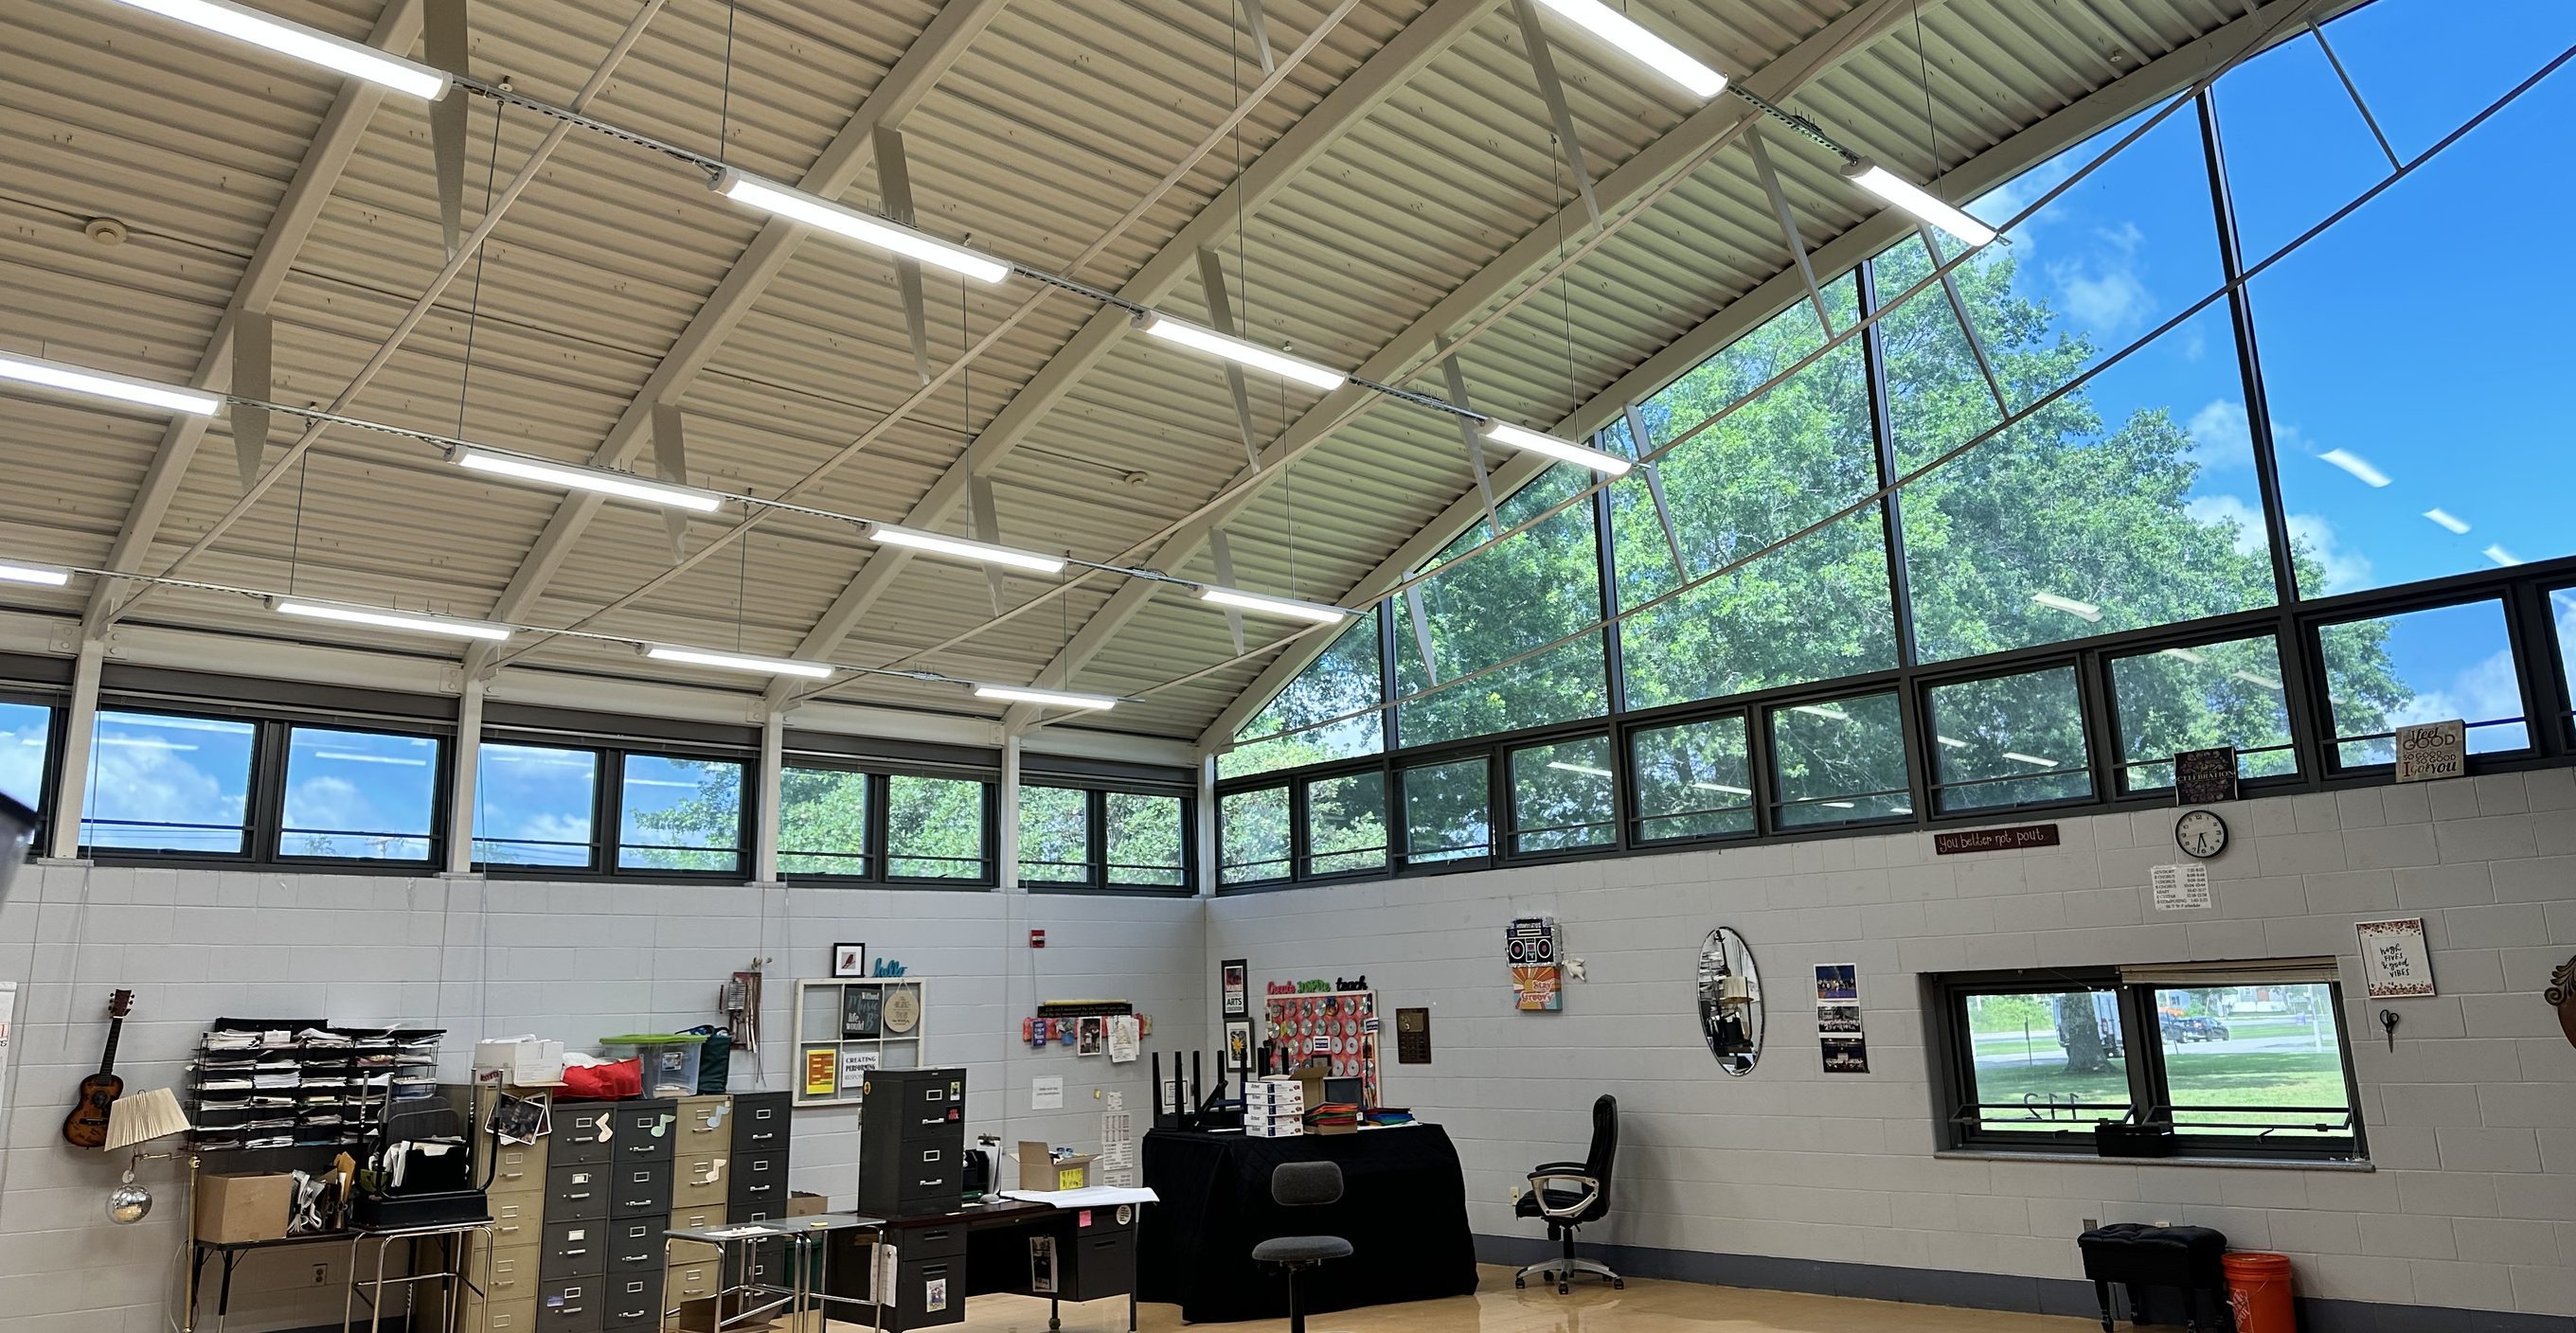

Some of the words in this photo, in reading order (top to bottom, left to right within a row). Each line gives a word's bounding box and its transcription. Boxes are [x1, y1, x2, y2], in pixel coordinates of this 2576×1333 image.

[2416, 727, 2439, 743] feel
[2403, 735, 2456, 751] GOOD
[2416, 751, 2442, 759] GOOD
[2429, 754, 2457, 763] GOOD
[2177, 770, 2235, 782] CELEBRATION
[2016, 827, 2044, 844] pout
[2384, 952, 2403, 961] FIVES
[872, 957, 908, 977] hello
[2388, 958, 2409, 970] good
[2389, 969, 2409, 978] VIBES
[1335, 975, 1368, 991] teach
[1532, 981, 1551, 990] Stay
[1226, 997, 1243, 1006] ARTS
[1521, 991, 1553, 1004] Groovy
[846, 1056, 877, 1064] CREATING
[845, 1063, 876, 1073] PERFORMING
